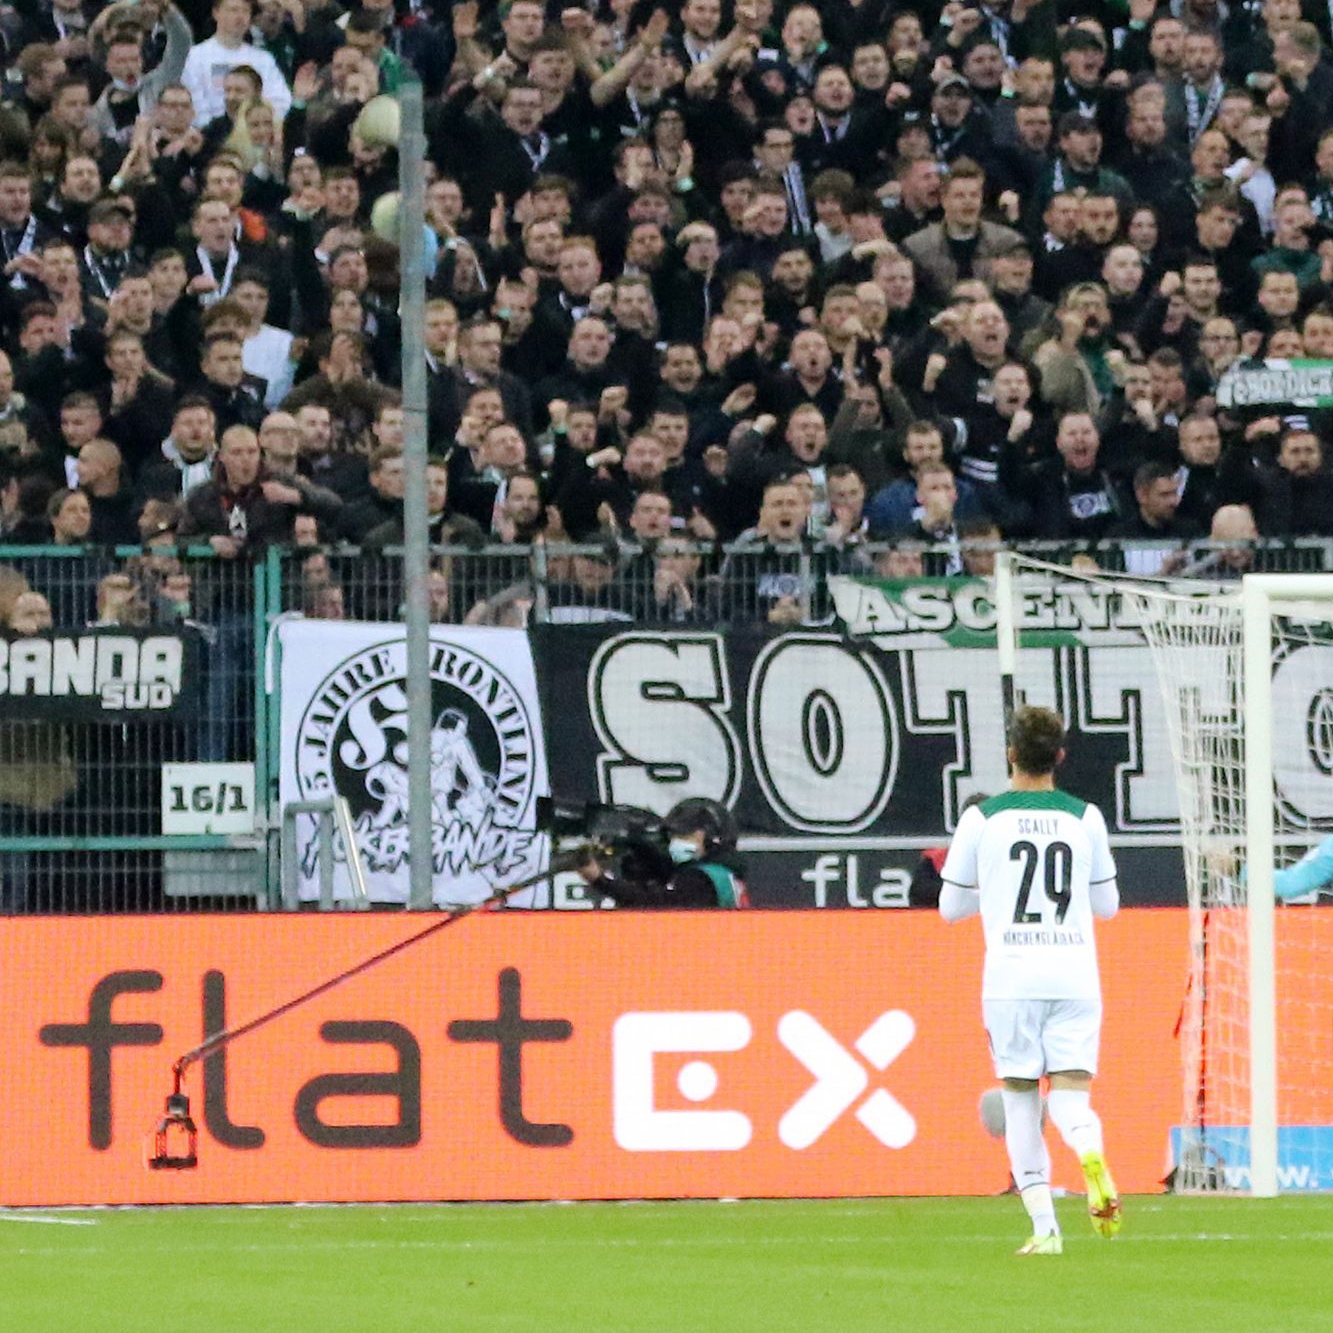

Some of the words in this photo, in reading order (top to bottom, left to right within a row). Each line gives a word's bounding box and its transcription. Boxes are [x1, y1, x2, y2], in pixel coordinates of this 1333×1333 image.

[0, 635, 183, 696] ANDA
[101, 682, 173, 710] SUD
[304, 649, 396, 759] JAHRE
[431, 647, 528, 819] RONTLINE
[169, 782, 248, 815] 16/1
[1018, 818, 1058, 835] SCALLY
[1009, 840, 1072, 925] 29
